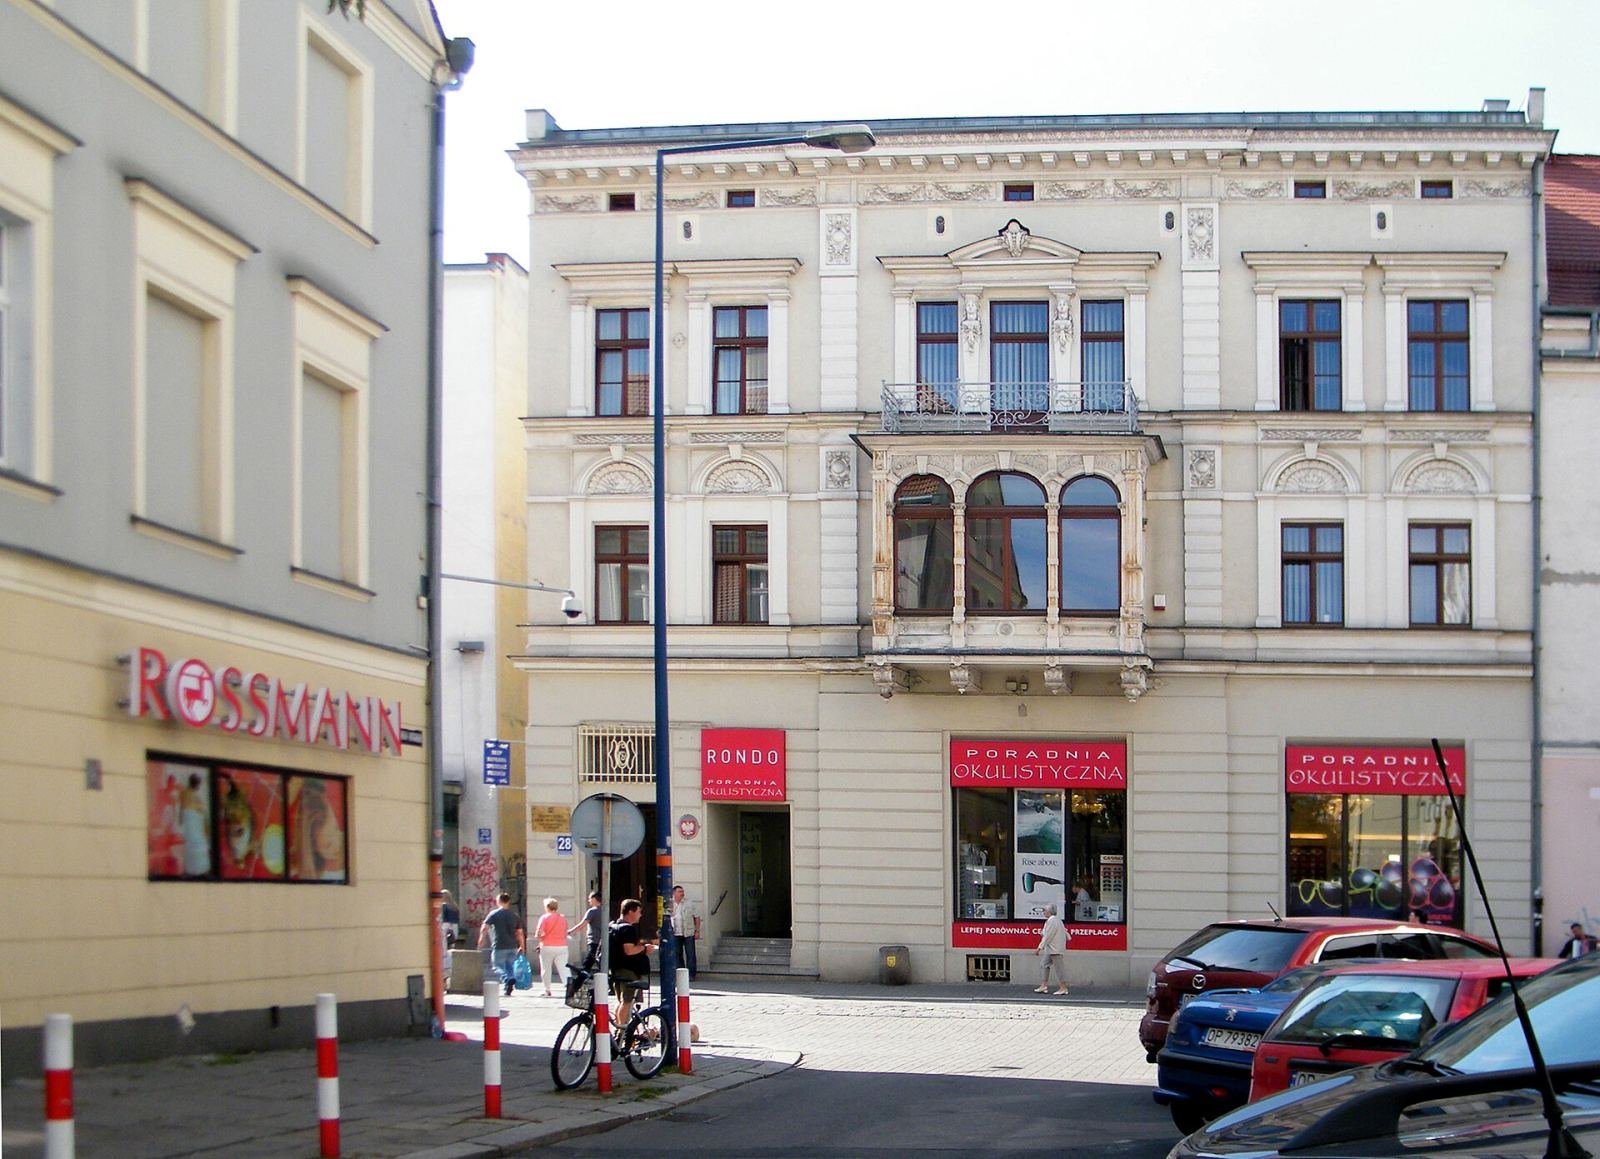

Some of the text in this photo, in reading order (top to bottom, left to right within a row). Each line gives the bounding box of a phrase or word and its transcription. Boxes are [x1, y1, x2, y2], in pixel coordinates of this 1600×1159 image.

[131, 646, 402, 757] ROSSMANN
[707, 749, 778, 765] RONDO
[966, 749, 1110, 760] PORADNIA
[953, 763, 1123, 781] OKULISTYCZNA
[1289, 769, 1462, 787] OKULISTYCZNA
[703, 787, 783, 797] OKULISTYCZNA
[558, 837, 572, 850] 28
[961, 926, 983, 935] LEPIEJ
[985, 925, 1030, 936] PORÓWNAĆ
[1070, 927, 1119, 937] PRZEPŁACAĆ
[1207, 1029, 1259, 1048] OP 79382
